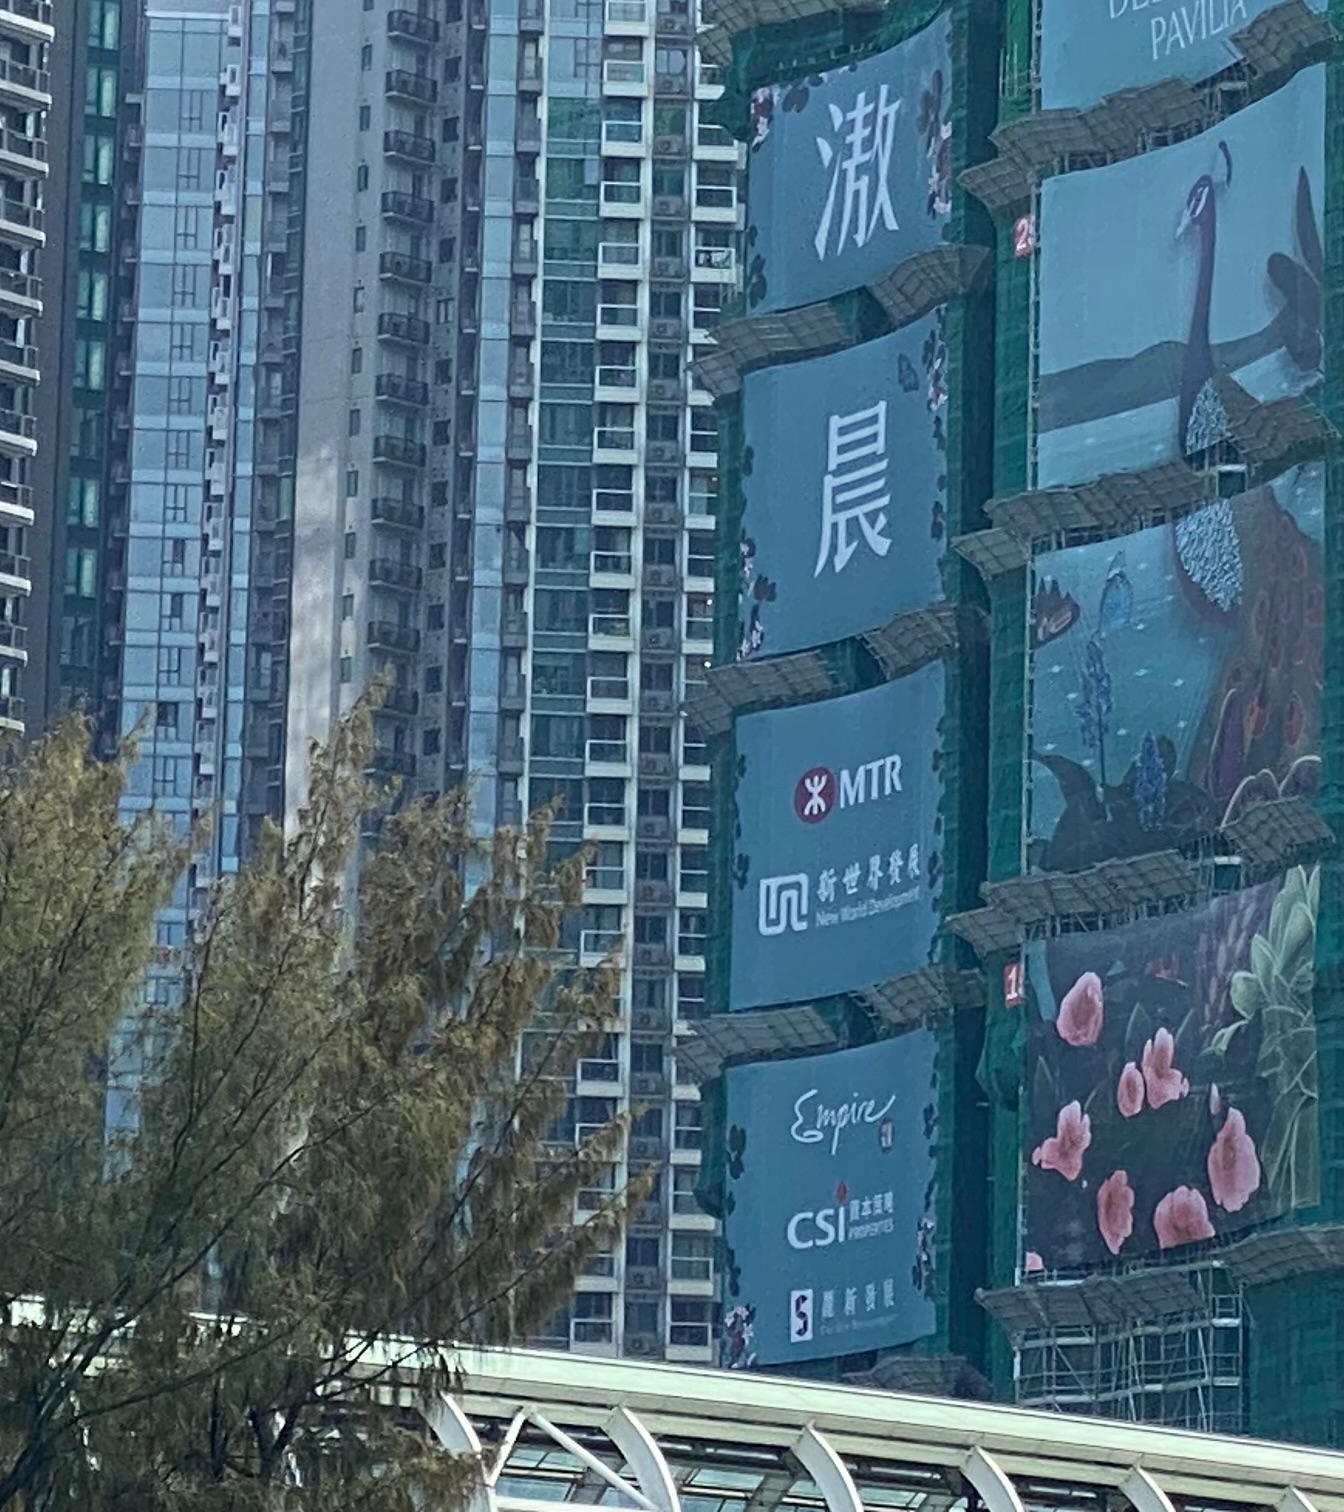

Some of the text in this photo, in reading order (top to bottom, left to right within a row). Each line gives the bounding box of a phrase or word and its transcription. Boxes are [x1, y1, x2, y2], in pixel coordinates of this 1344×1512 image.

[813, 399, 893, 578] 晨
[839, 754, 903, 809] MTR
[791, 1088, 896, 1156] Empire
